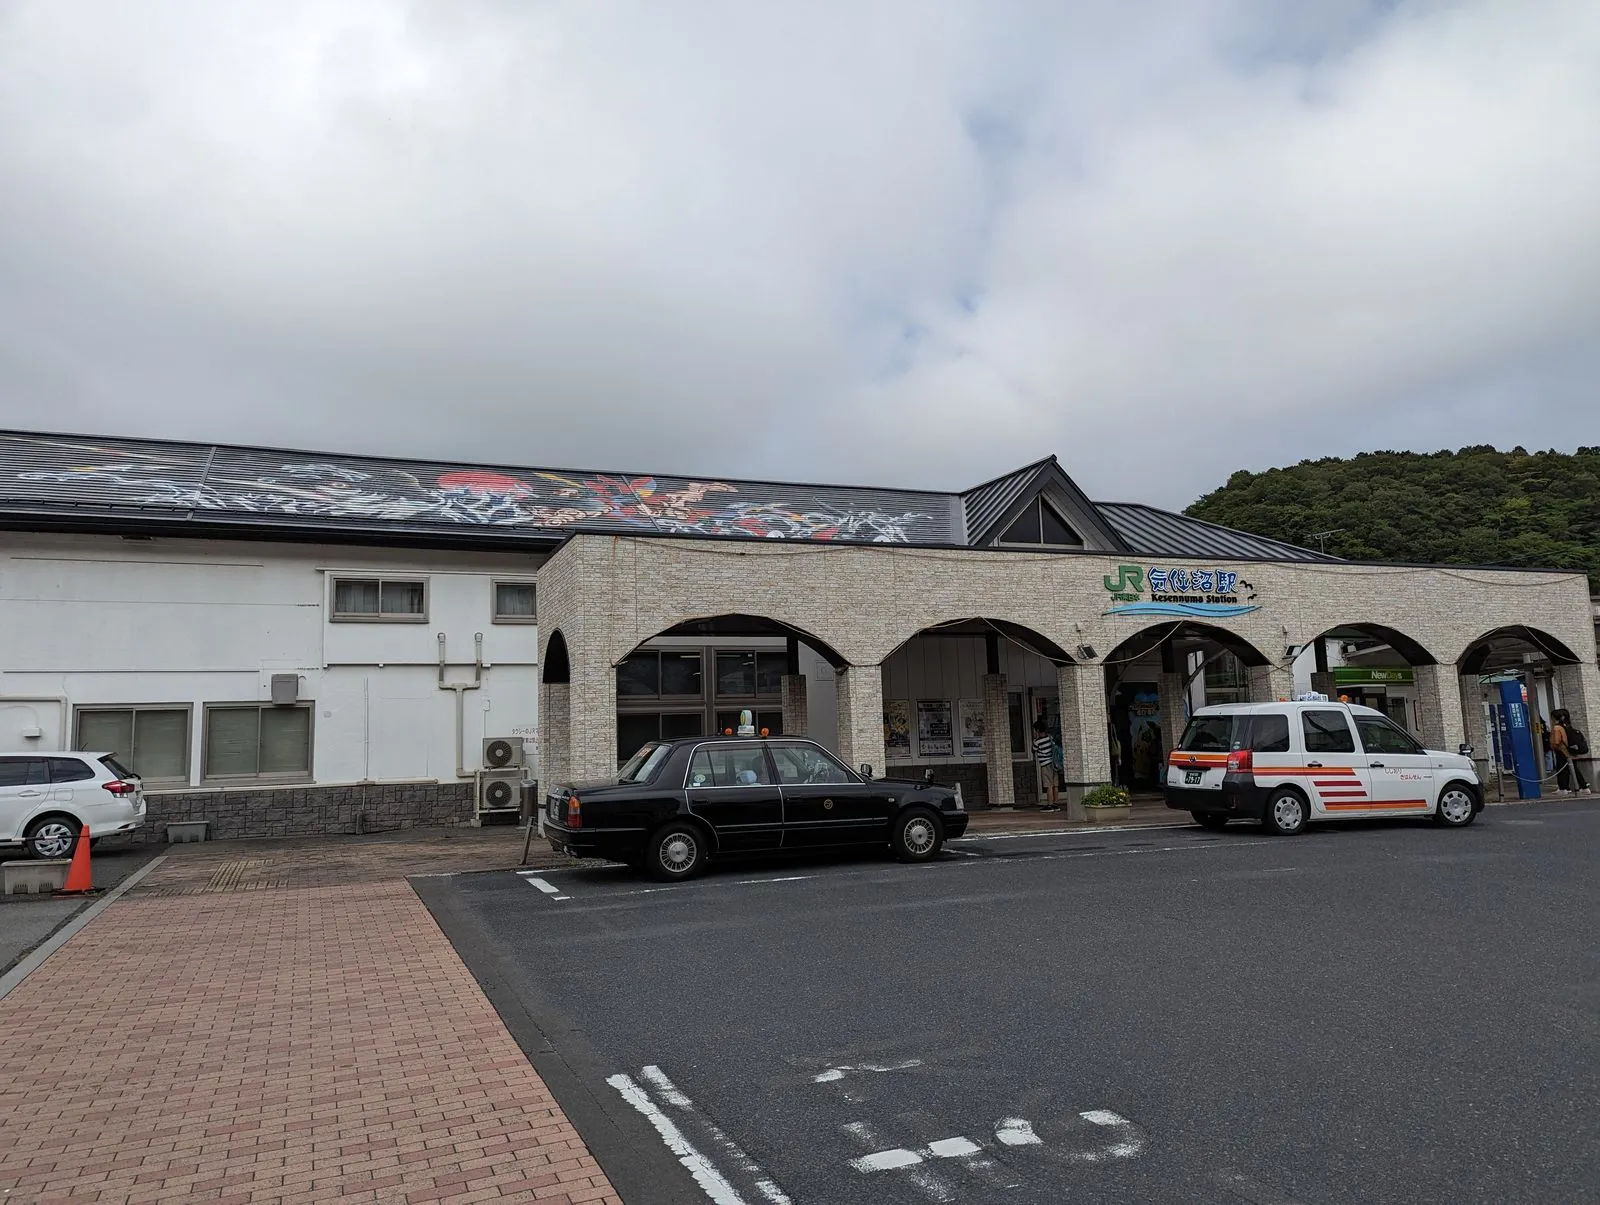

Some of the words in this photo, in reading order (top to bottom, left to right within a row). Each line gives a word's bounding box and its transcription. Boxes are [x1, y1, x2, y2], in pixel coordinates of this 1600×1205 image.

[1104, 565, 1144, 592] JR
[1148, 566, 1239, 594] 気仙沼駅
[1151, 593, 1204, 603] Kesennuma
[1205, 594, 1238, 604] Station
